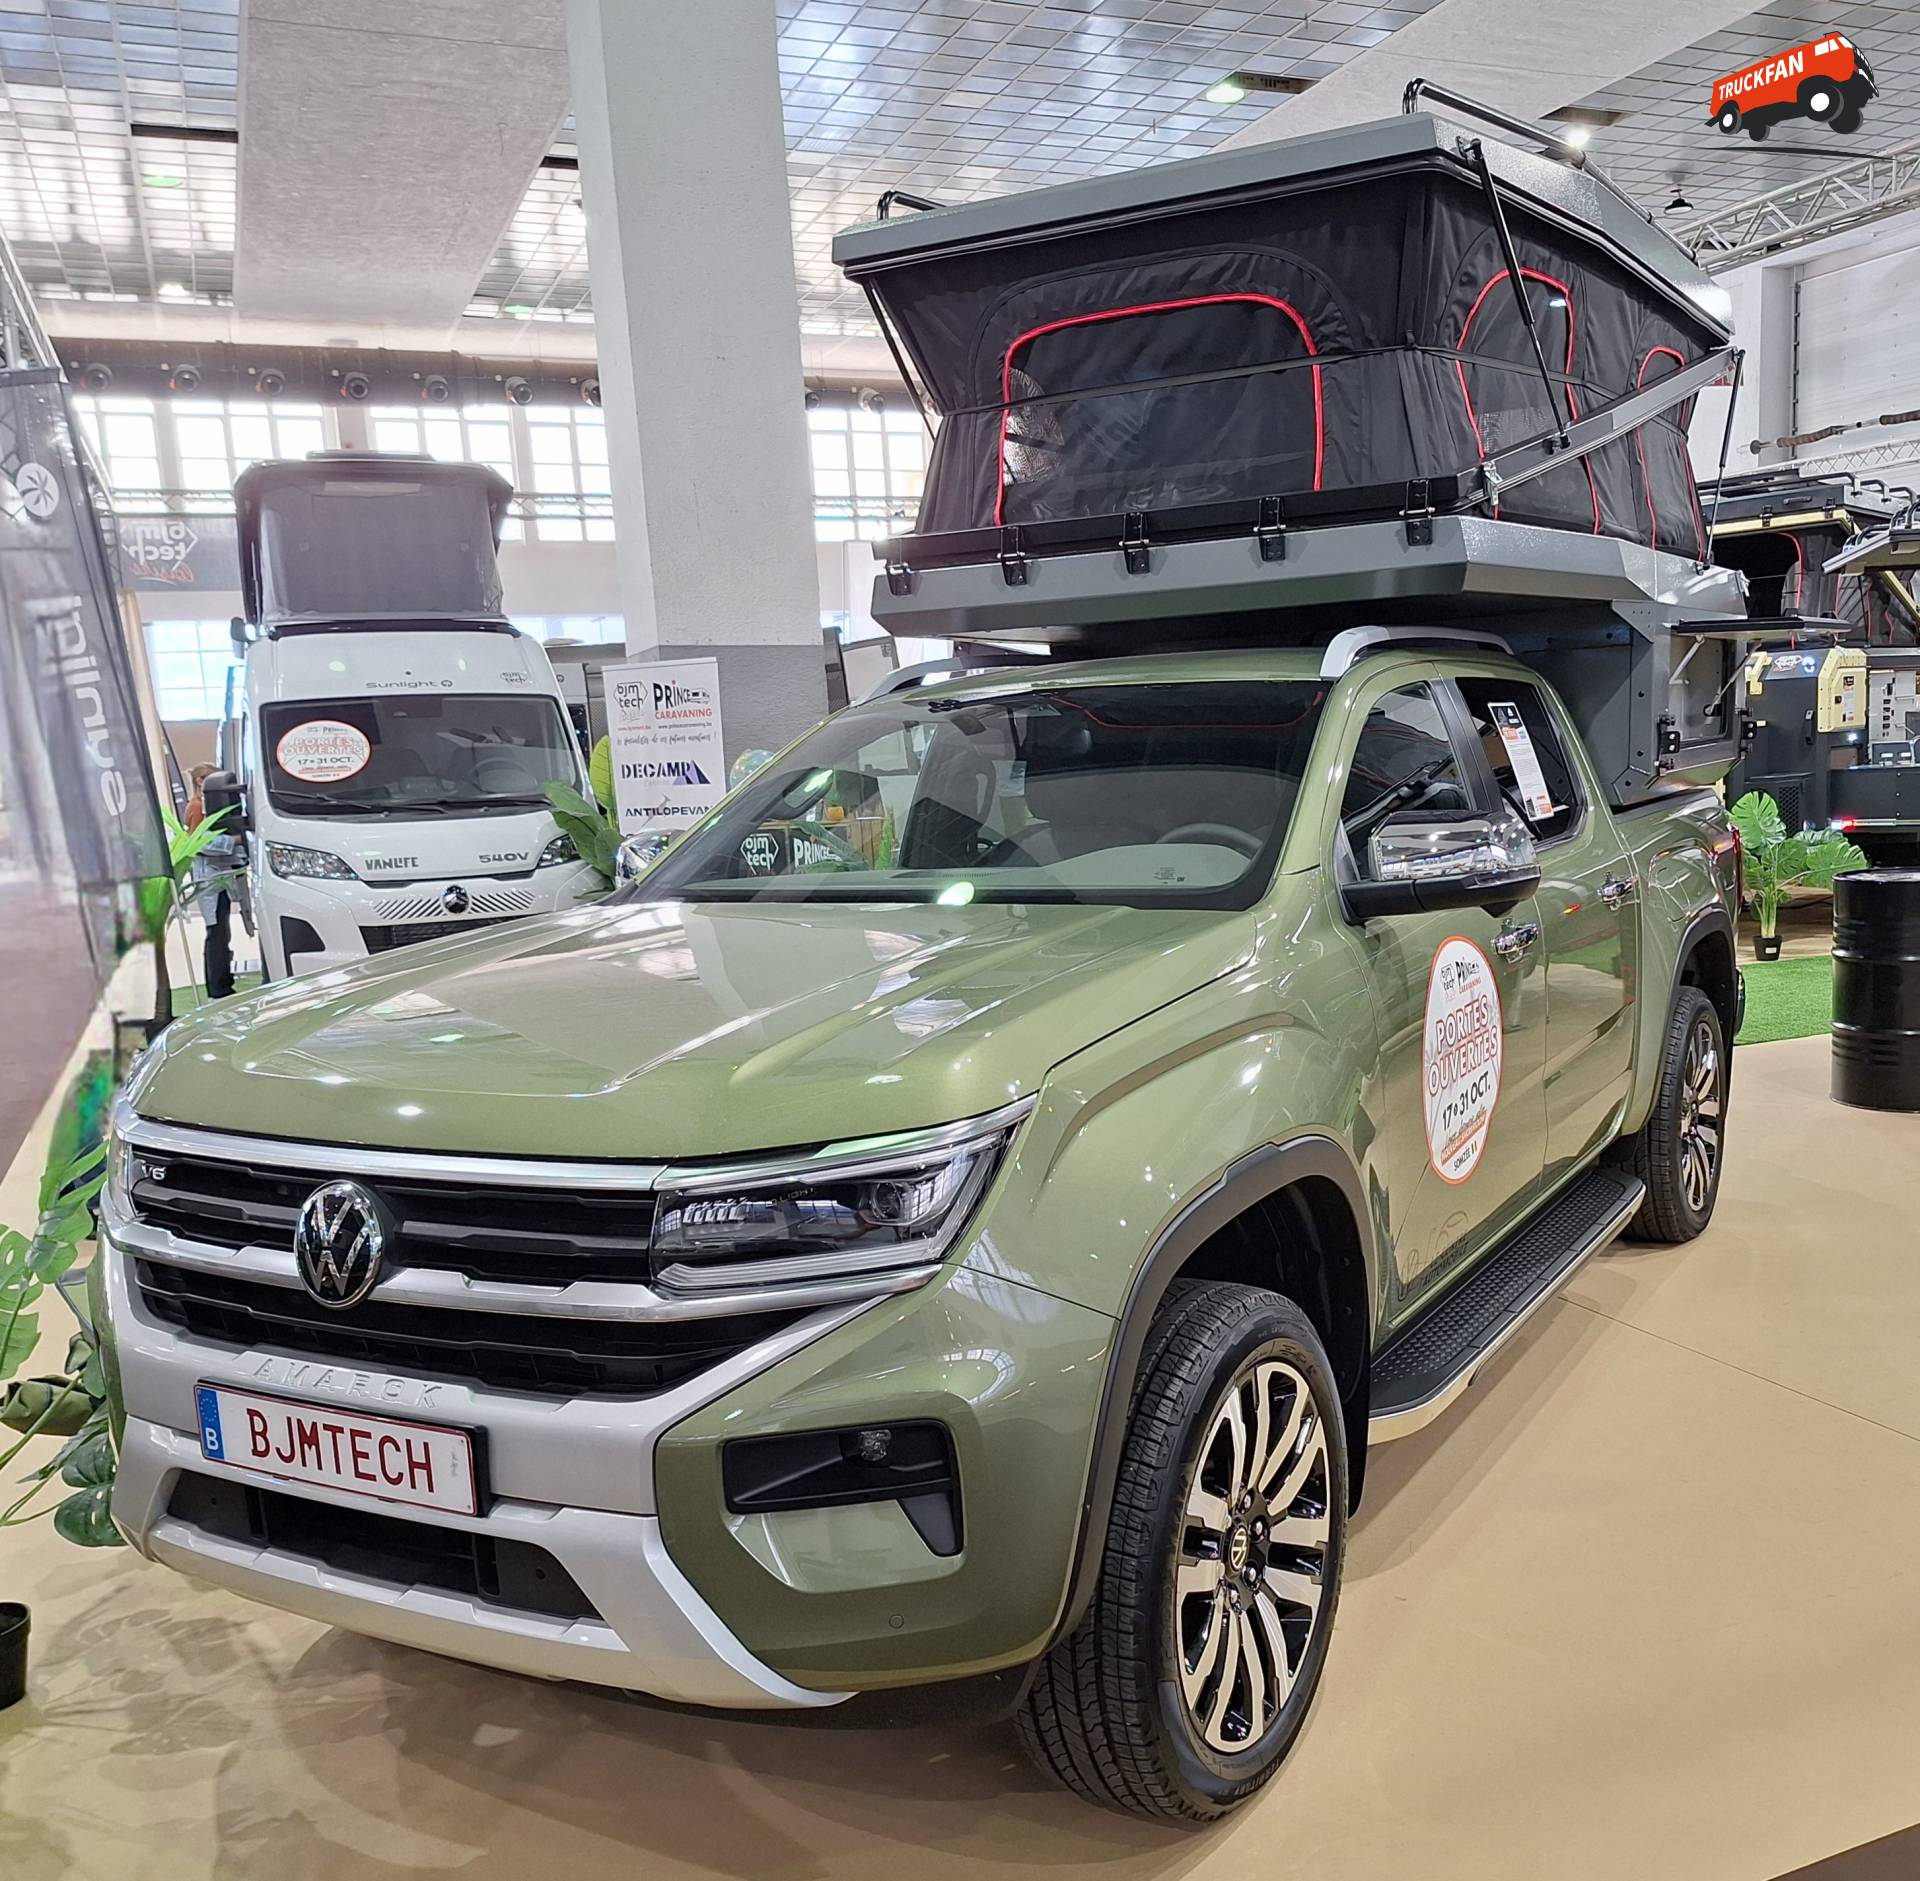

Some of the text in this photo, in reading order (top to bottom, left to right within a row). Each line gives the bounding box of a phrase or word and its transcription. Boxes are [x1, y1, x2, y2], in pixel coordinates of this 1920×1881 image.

[365, 680, 440, 689] Sunlight
[618, 696, 644, 711] tech
[655, 708, 712, 720] CARAVANING
[365, 856, 419, 871] VANLIFE
[479, 852, 529, 864] 540V
[1435, 994, 1488, 1055] PORTES
[1428, 1026, 1498, 1098] OUVERTES
[1442, 1102, 1453, 1131] 17
[1459, 1088, 1469, 1116] 31
[1470, 1070, 1491, 1104] OCT.
[140, 1160, 169, 1181] V6
[252, 1358, 443, 1409] AMAROK
[204, 1426, 220, 1451] B
[246, 1407, 435, 1494] BJMTECH
